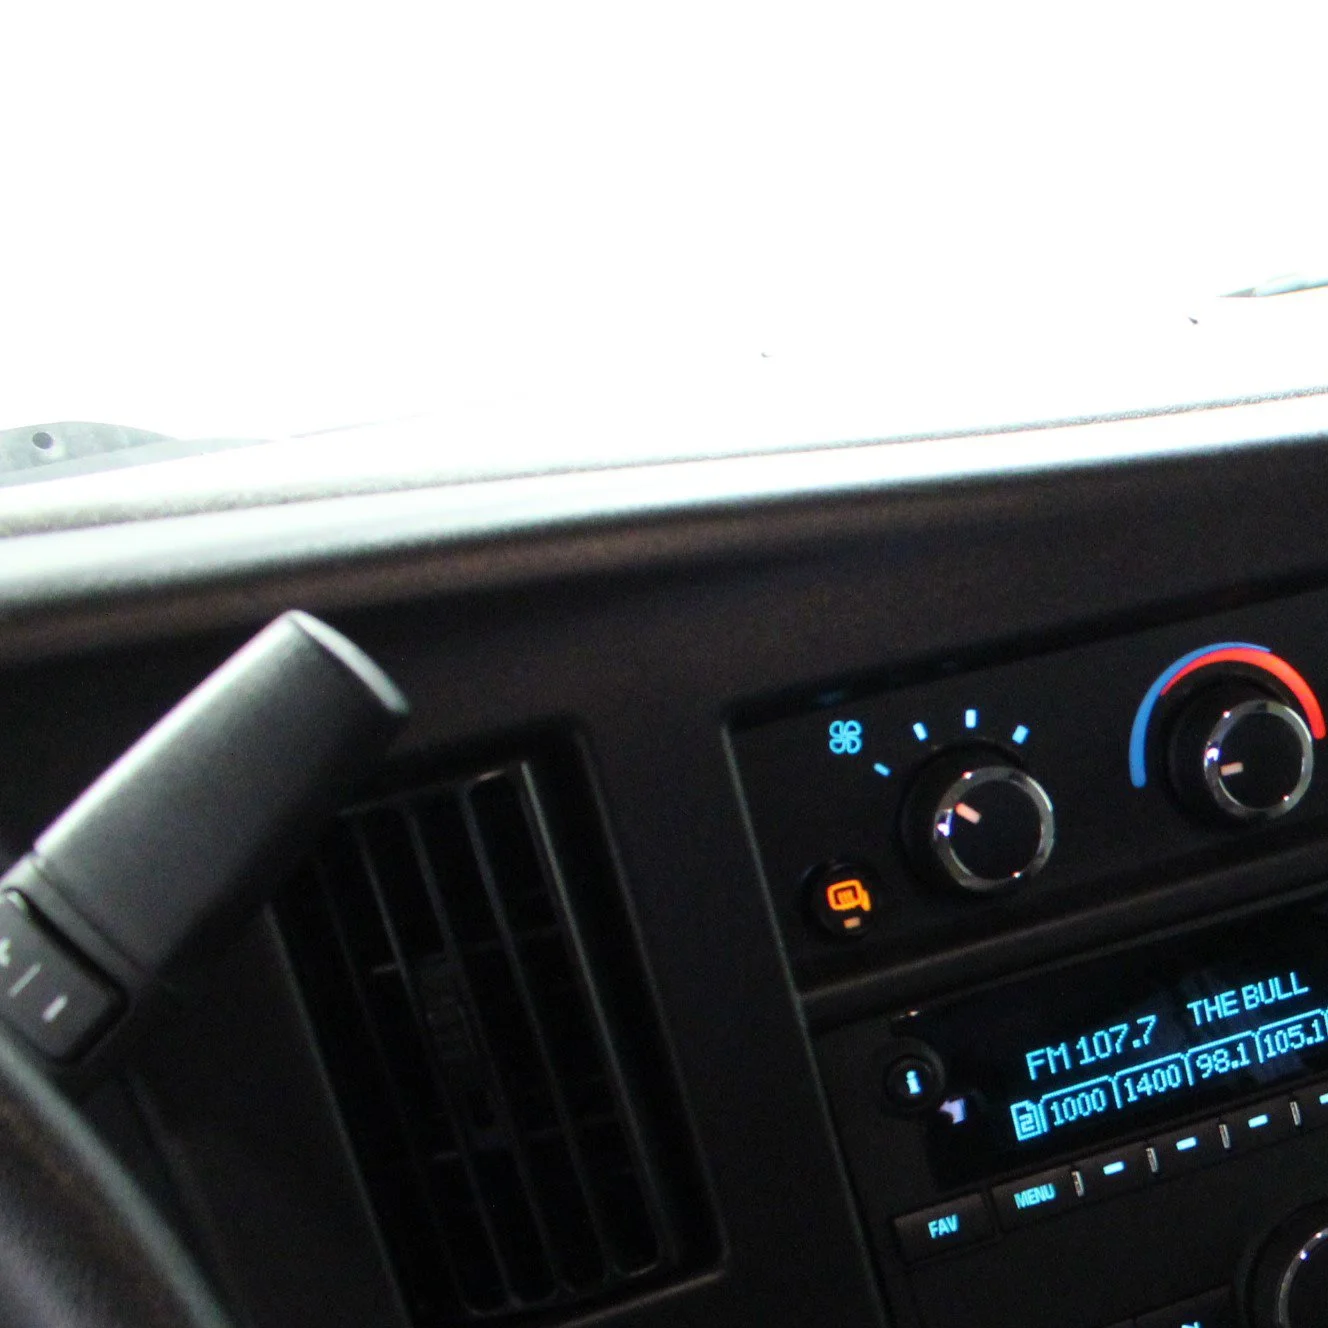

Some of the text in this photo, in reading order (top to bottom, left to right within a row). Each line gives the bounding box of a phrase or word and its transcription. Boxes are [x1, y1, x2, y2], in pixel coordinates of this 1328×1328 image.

[1026, 971, 1310, 1080] FM 107.7 THE BULL
[1050, 1086, 1107, 1127] 1000
[1123, 1064, 1184, 1102] 1400
[1197, 1042, 1250, 1079] 98.1
[1265, 1018, 1325, 1058] 105.1
[928, 1214, 959, 1239] FAV
[1013, 1183, 1056, 1209] MENU
